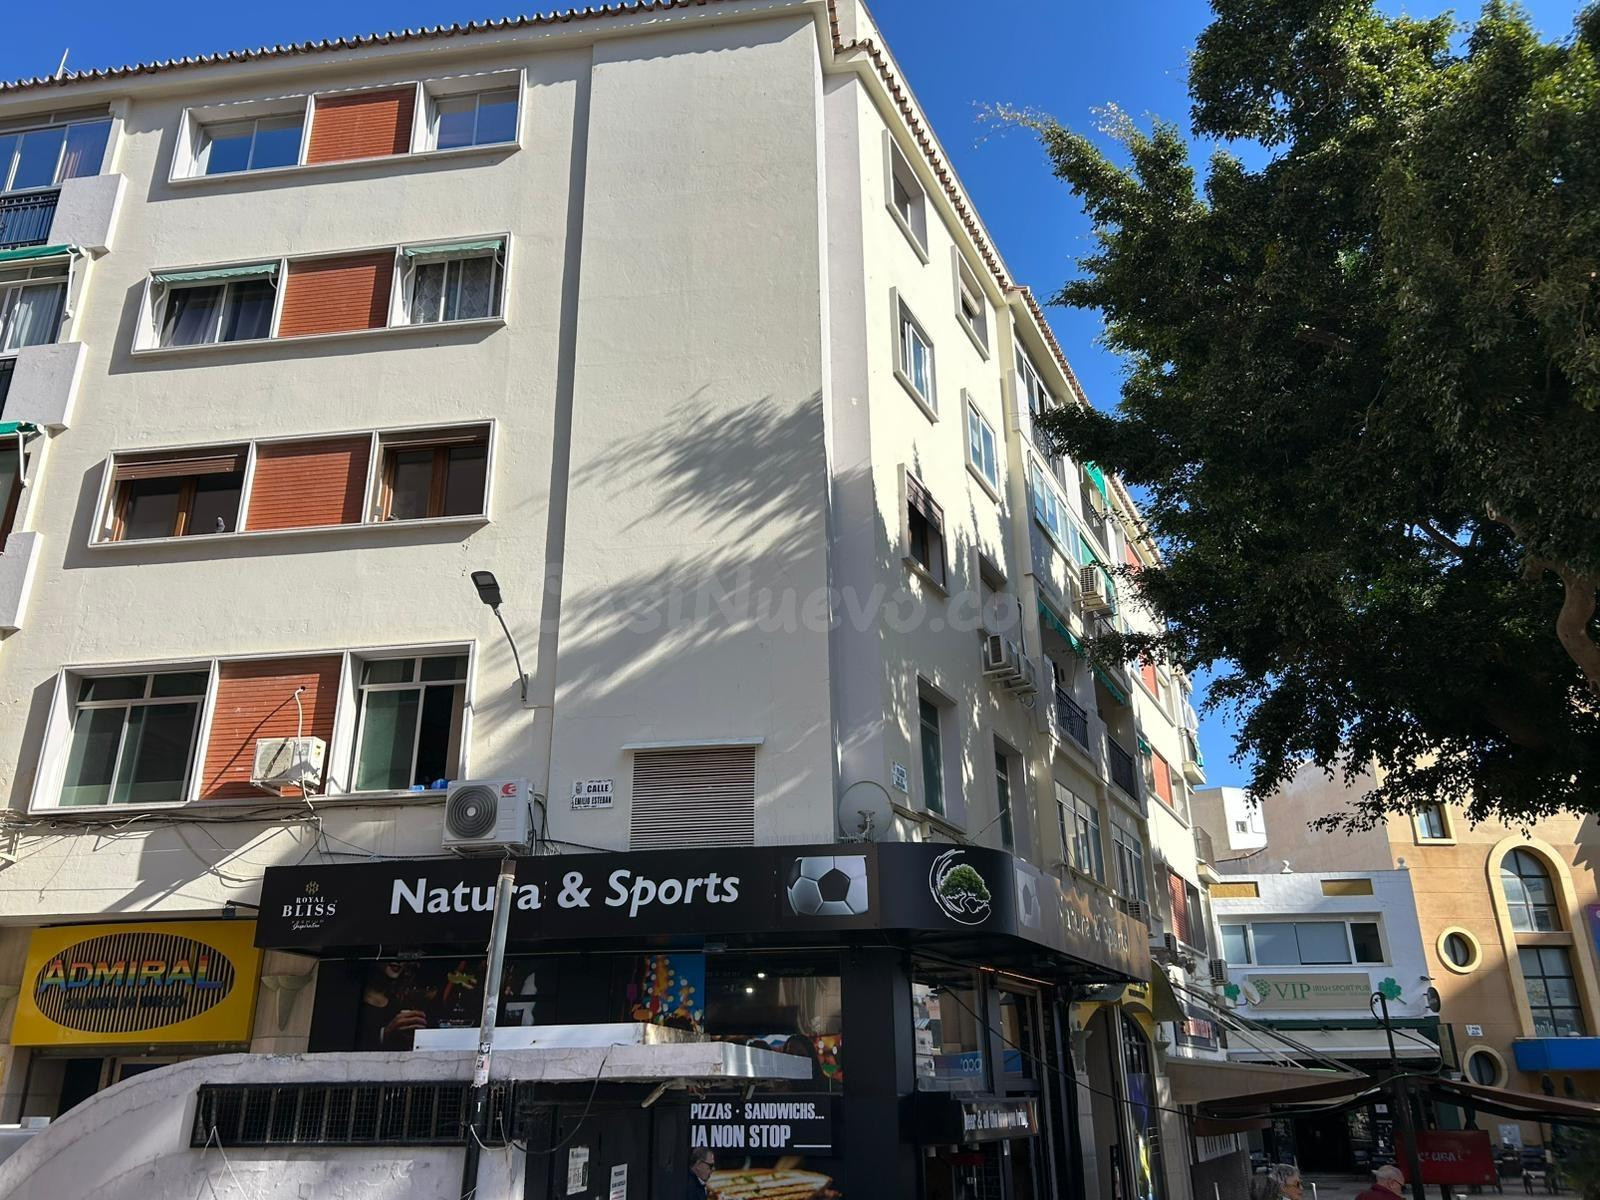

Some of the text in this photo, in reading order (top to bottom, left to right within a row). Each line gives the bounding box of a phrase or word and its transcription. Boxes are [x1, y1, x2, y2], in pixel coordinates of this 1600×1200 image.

[587, 784, 609, 793] CALLE
[574, 796, 612, 805] EMILIO ESTEBAN
[557, 871, 591, 909] &
[604, 869, 739, 918] Sports
[282, 903, 336, 917] BLISS
[38, 954, 224, 993] ADMIRAL
[1274, 983, 1311, 1000] VIP
[690, 1102, 732, 1120] PIZZAS
[710, 1124, 745, 1148] NON
[749, 1124, 791, 1148] STOP
